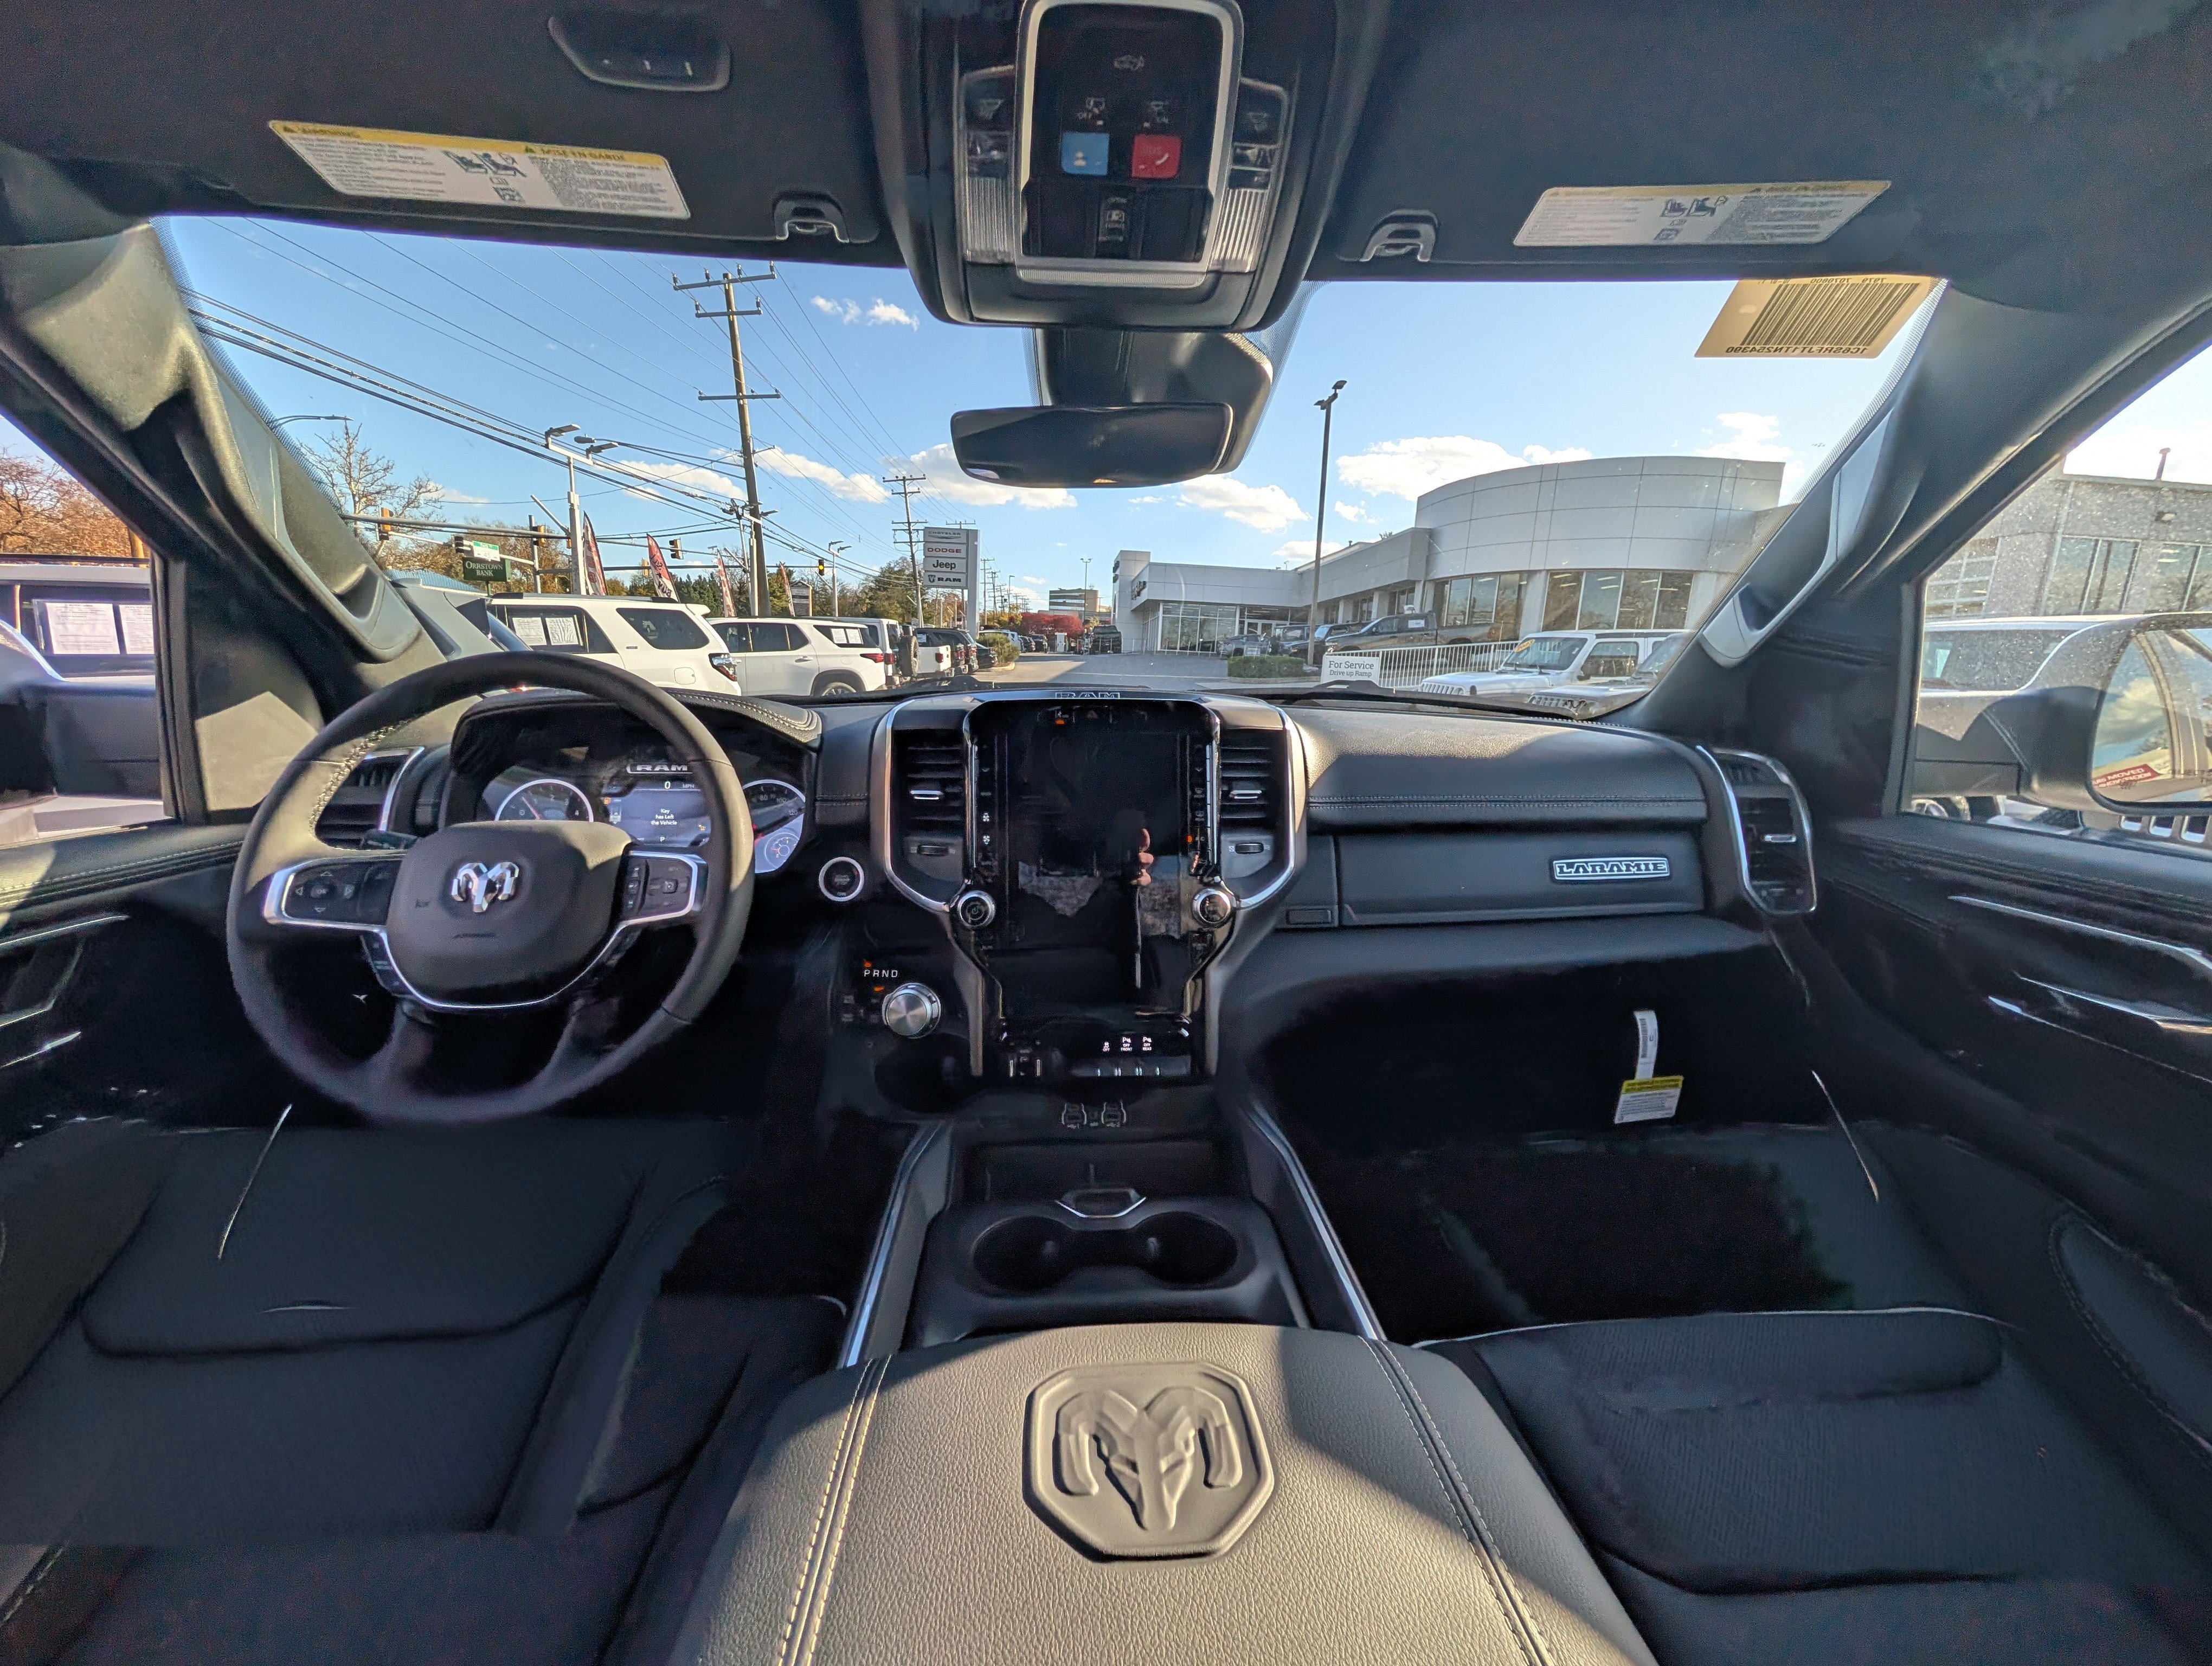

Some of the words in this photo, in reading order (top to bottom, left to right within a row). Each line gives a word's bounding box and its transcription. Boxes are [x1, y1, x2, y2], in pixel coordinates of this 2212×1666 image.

[465, 561, 503, 570] ORRSTOWN
[933, 560, 956, 571] Jeep
[1328, 661, 1343, 669] For
[1345, 661, 1374, 670] Service
[664, 781, 671, 790] 0
[1556, 861, 1668, 876] LARAMIE
